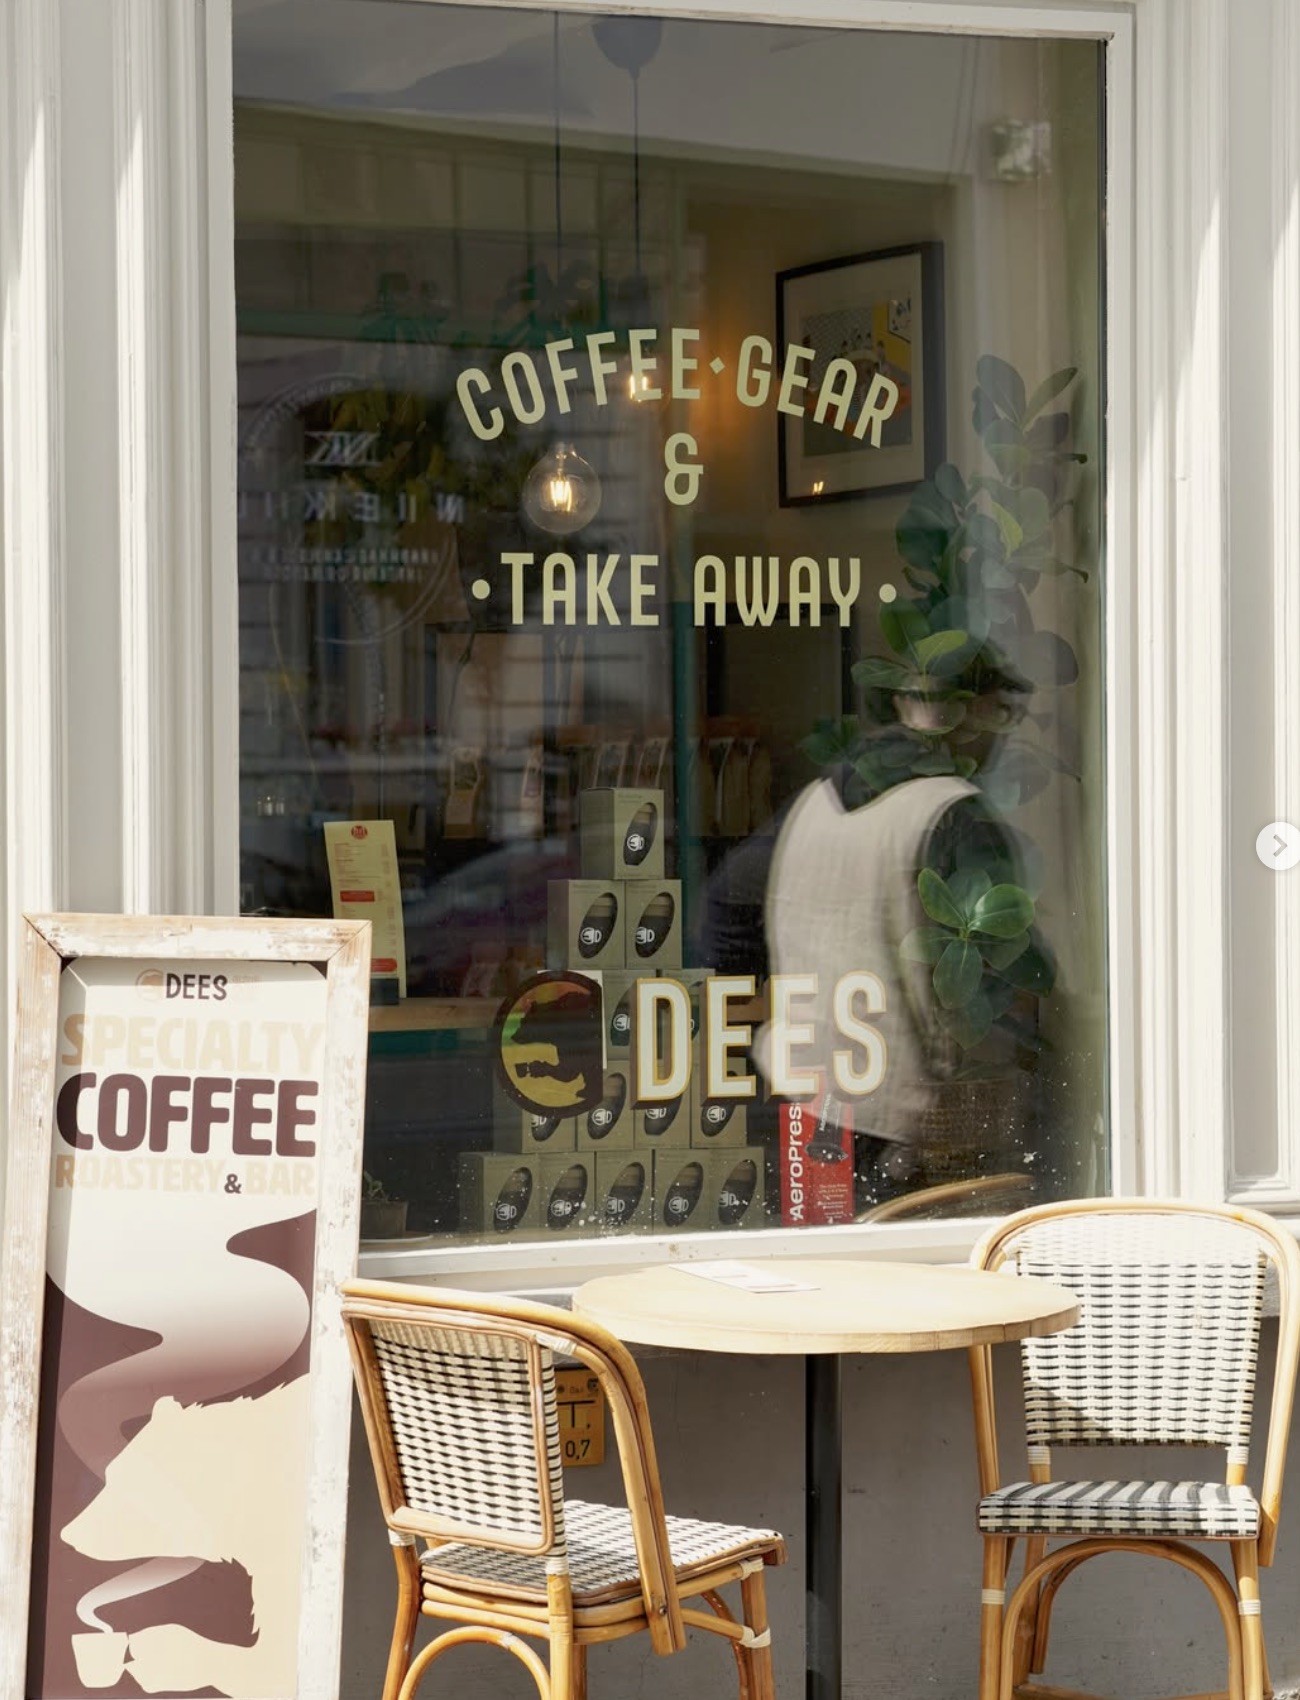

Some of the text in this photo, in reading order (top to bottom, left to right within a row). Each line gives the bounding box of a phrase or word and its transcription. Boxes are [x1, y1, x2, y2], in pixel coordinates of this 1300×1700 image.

[456, 327, 700, 441] COFFEE
[736, 335, 899, 448] GEAR
[664, 432, 703, 505] &
[501, 552, 861, 627] TAKE AWAY
[165, 972, 228, 1000] DEES
[61, 1013, 325, 1073] SPECIALTY
[633, 970, 888, 1105] DEES
[56, 1072, 319, 1157] COFFEE
[55, 1154, 317, 1197] ROASTERY & BAR
[789, 1101, 804, 1221] AeroPres
